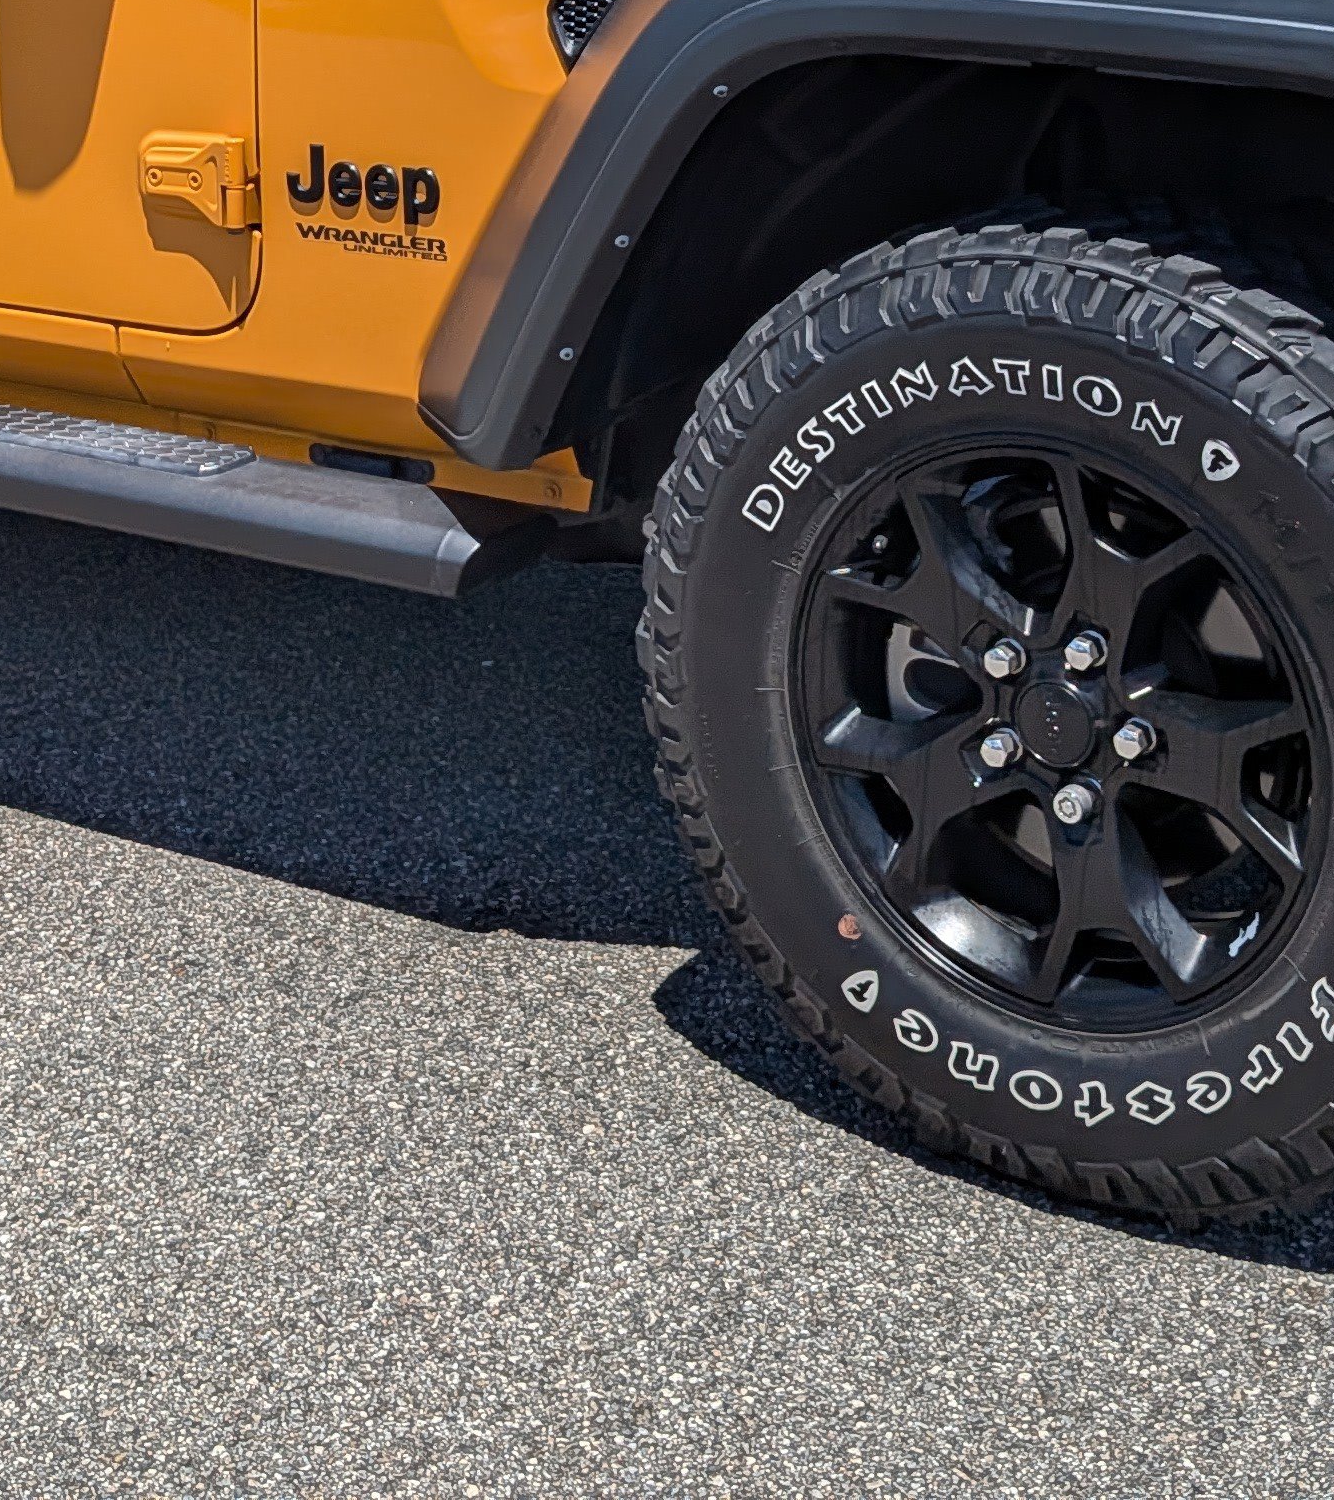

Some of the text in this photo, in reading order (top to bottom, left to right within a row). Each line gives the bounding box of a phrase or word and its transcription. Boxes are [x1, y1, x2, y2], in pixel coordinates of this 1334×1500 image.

[286, 143, 441, 226] Jeep
[296, 221, 447, 254] WRANGLER
[343, 243, 448, 262] UNLIMITED
[741, 356, 1183, 532] DESTINATION
